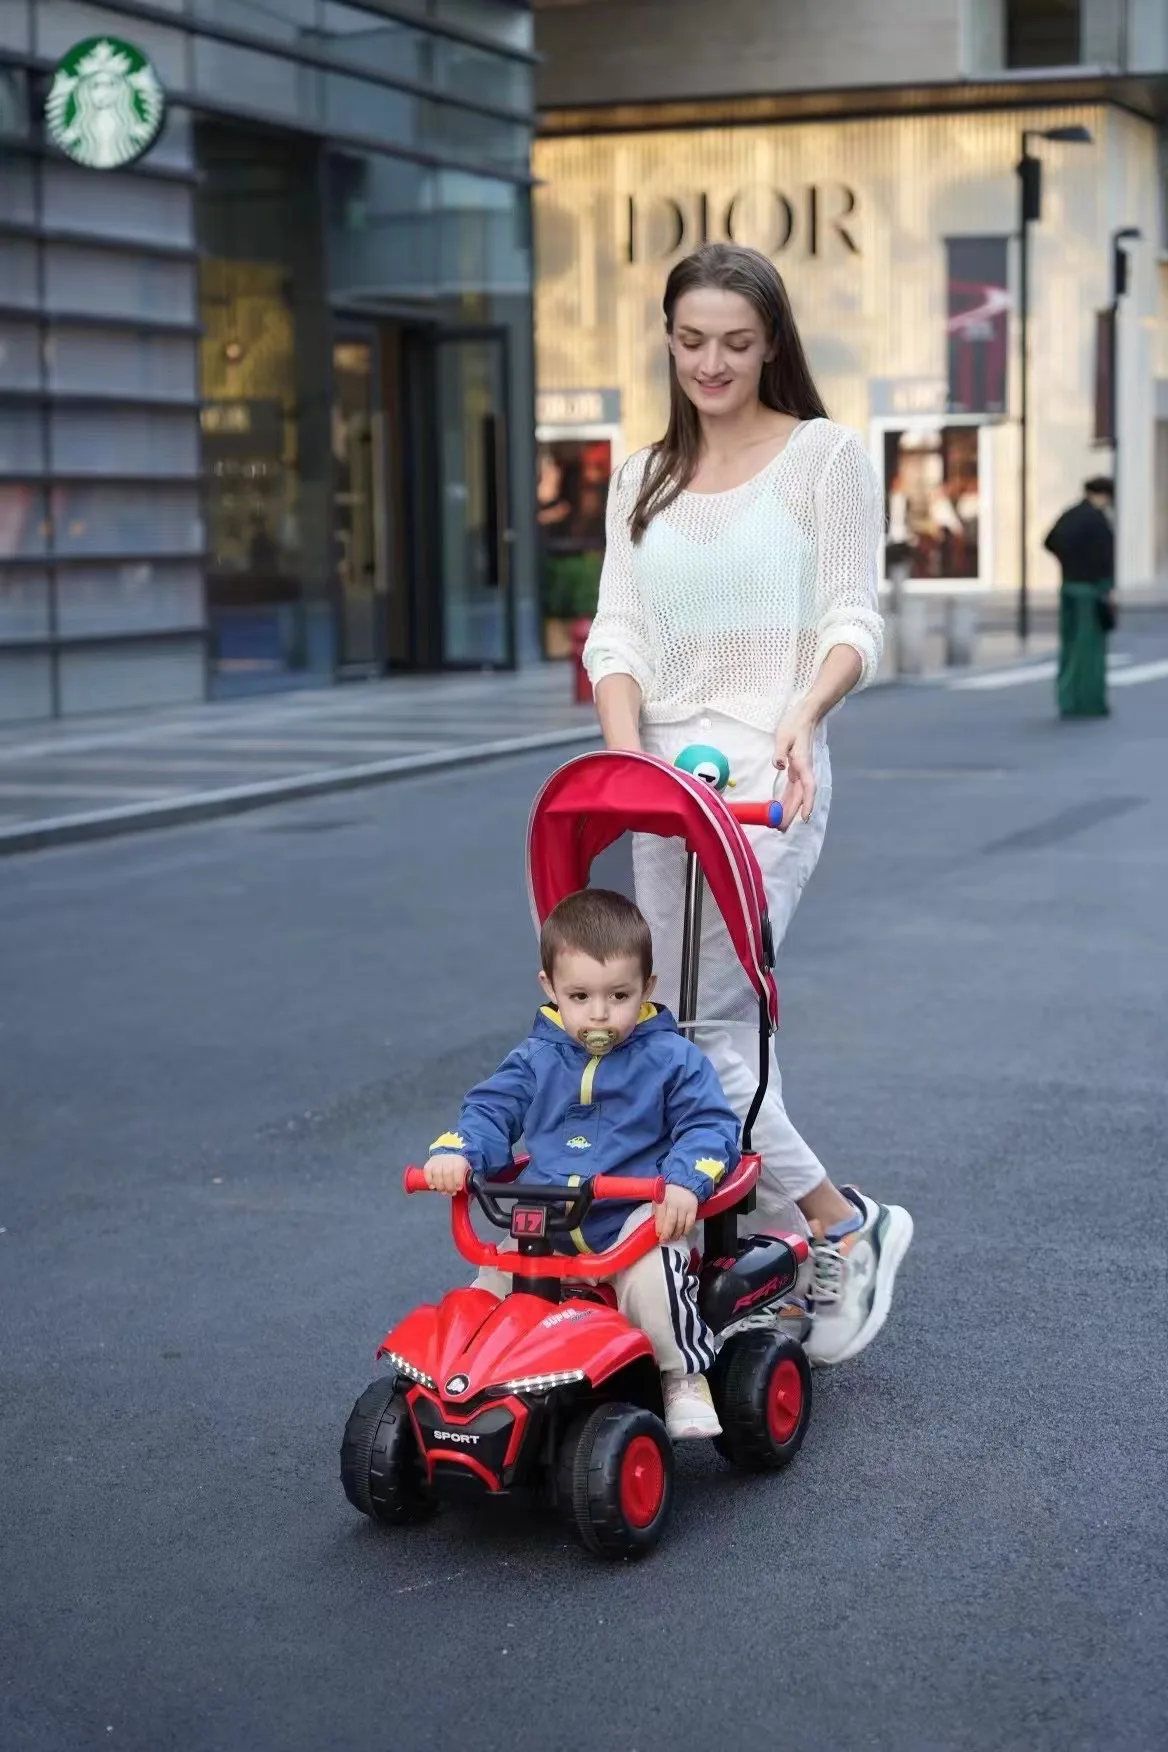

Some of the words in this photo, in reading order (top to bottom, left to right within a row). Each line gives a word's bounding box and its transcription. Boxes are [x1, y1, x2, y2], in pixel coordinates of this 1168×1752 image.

[625, 184, 861, 264] DIOR
[515, 1213, 542, 1232] 17
[433, 1430, 480, 1445] SPORT
